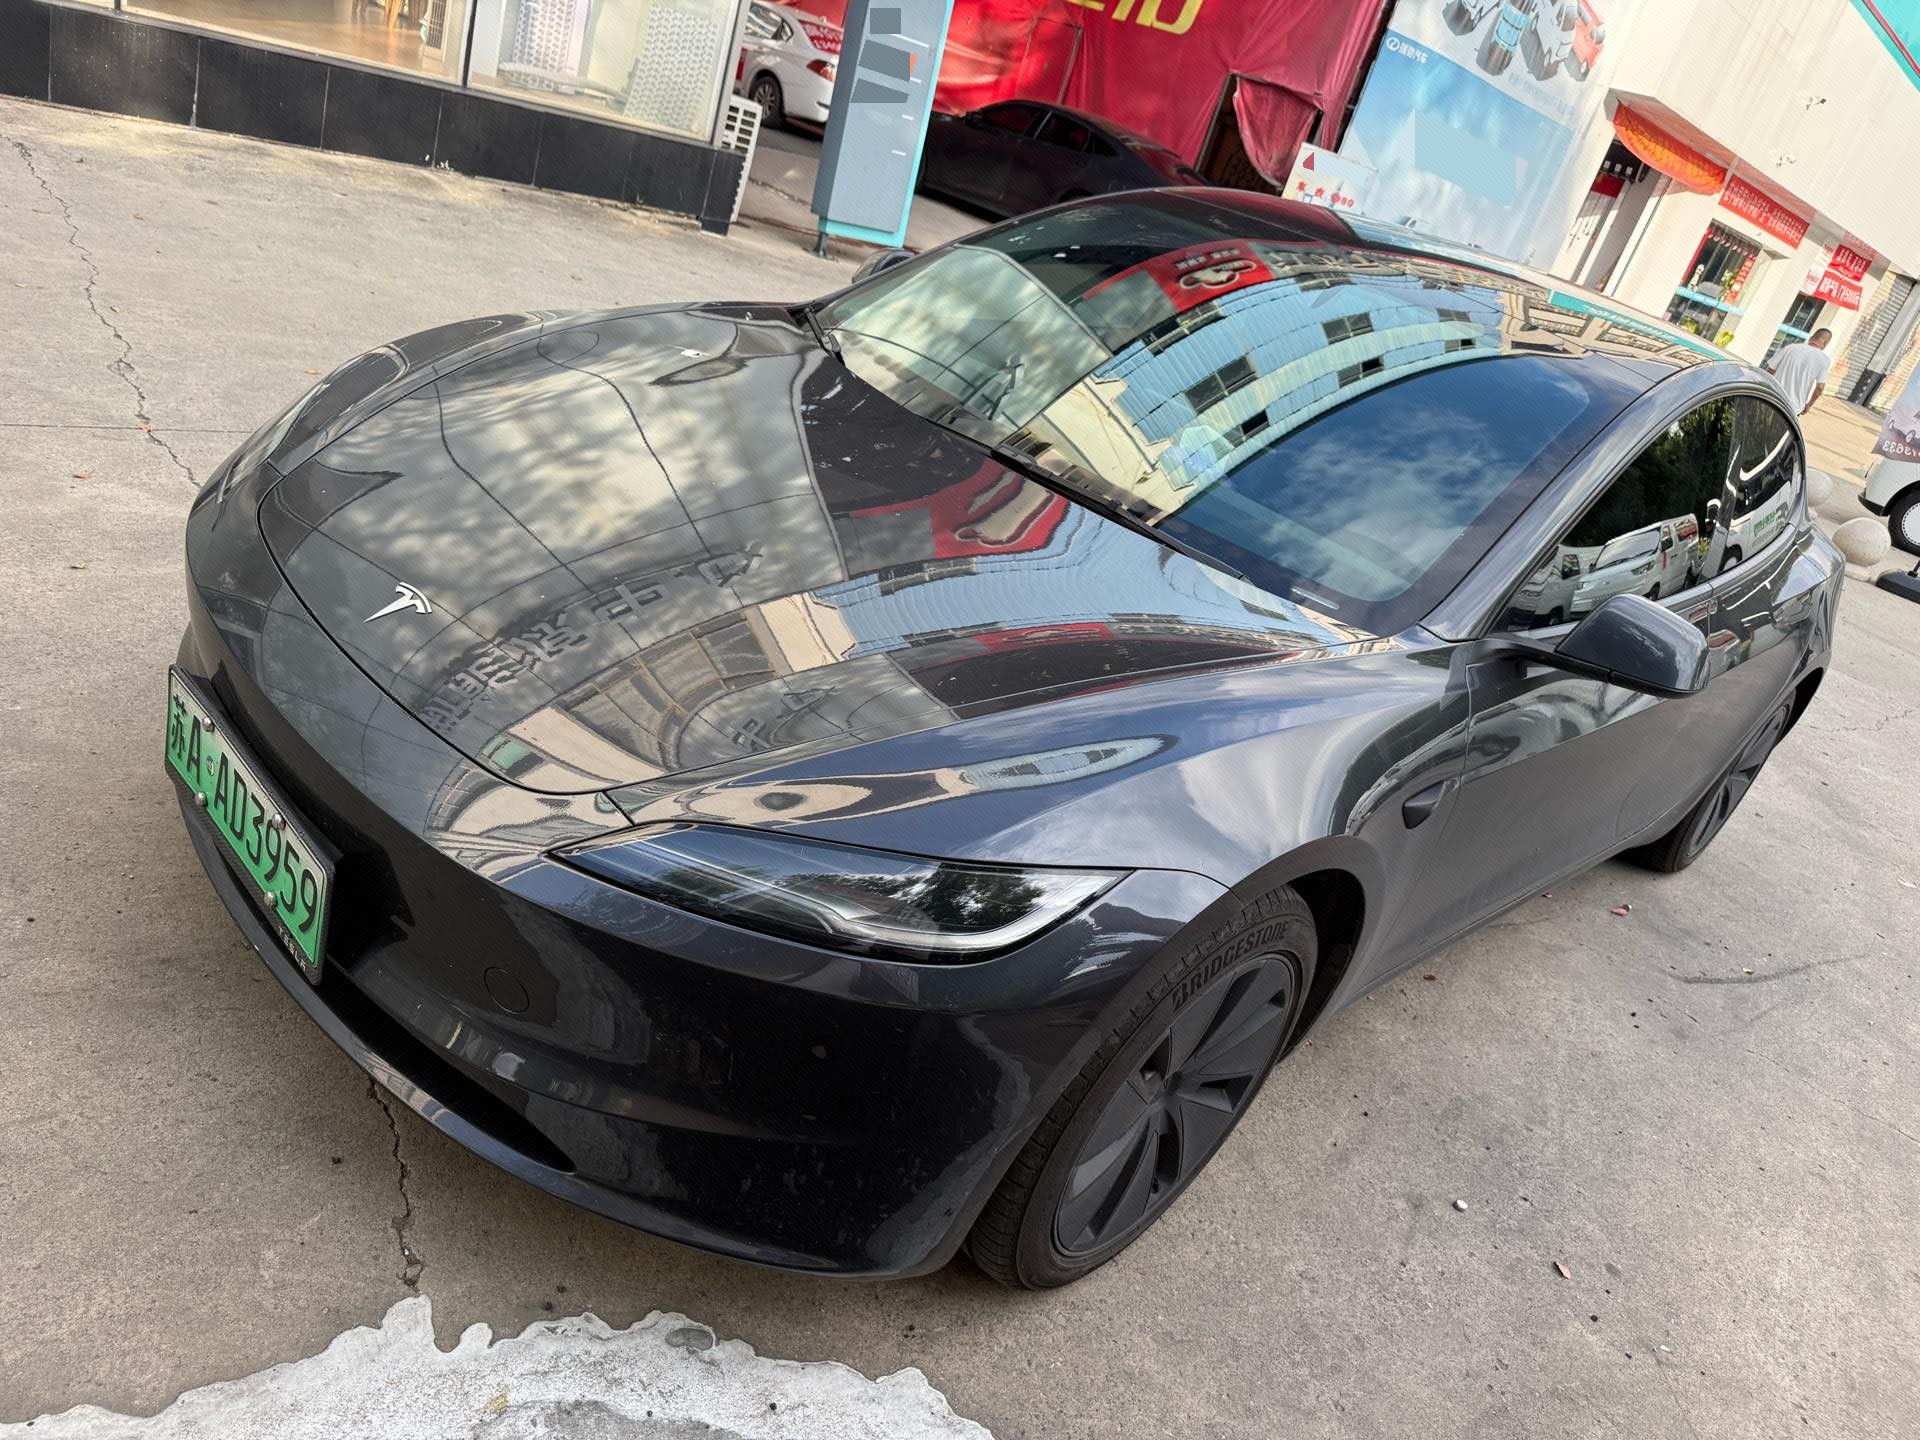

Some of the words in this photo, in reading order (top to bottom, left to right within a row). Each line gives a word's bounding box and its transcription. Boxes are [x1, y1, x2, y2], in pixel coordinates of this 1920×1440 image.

[213, 752, 318, 933] AD3959
[278, 924, 306, 971] TESLA
[1172, 920, 1289, 1013] BRIDGESTONE
